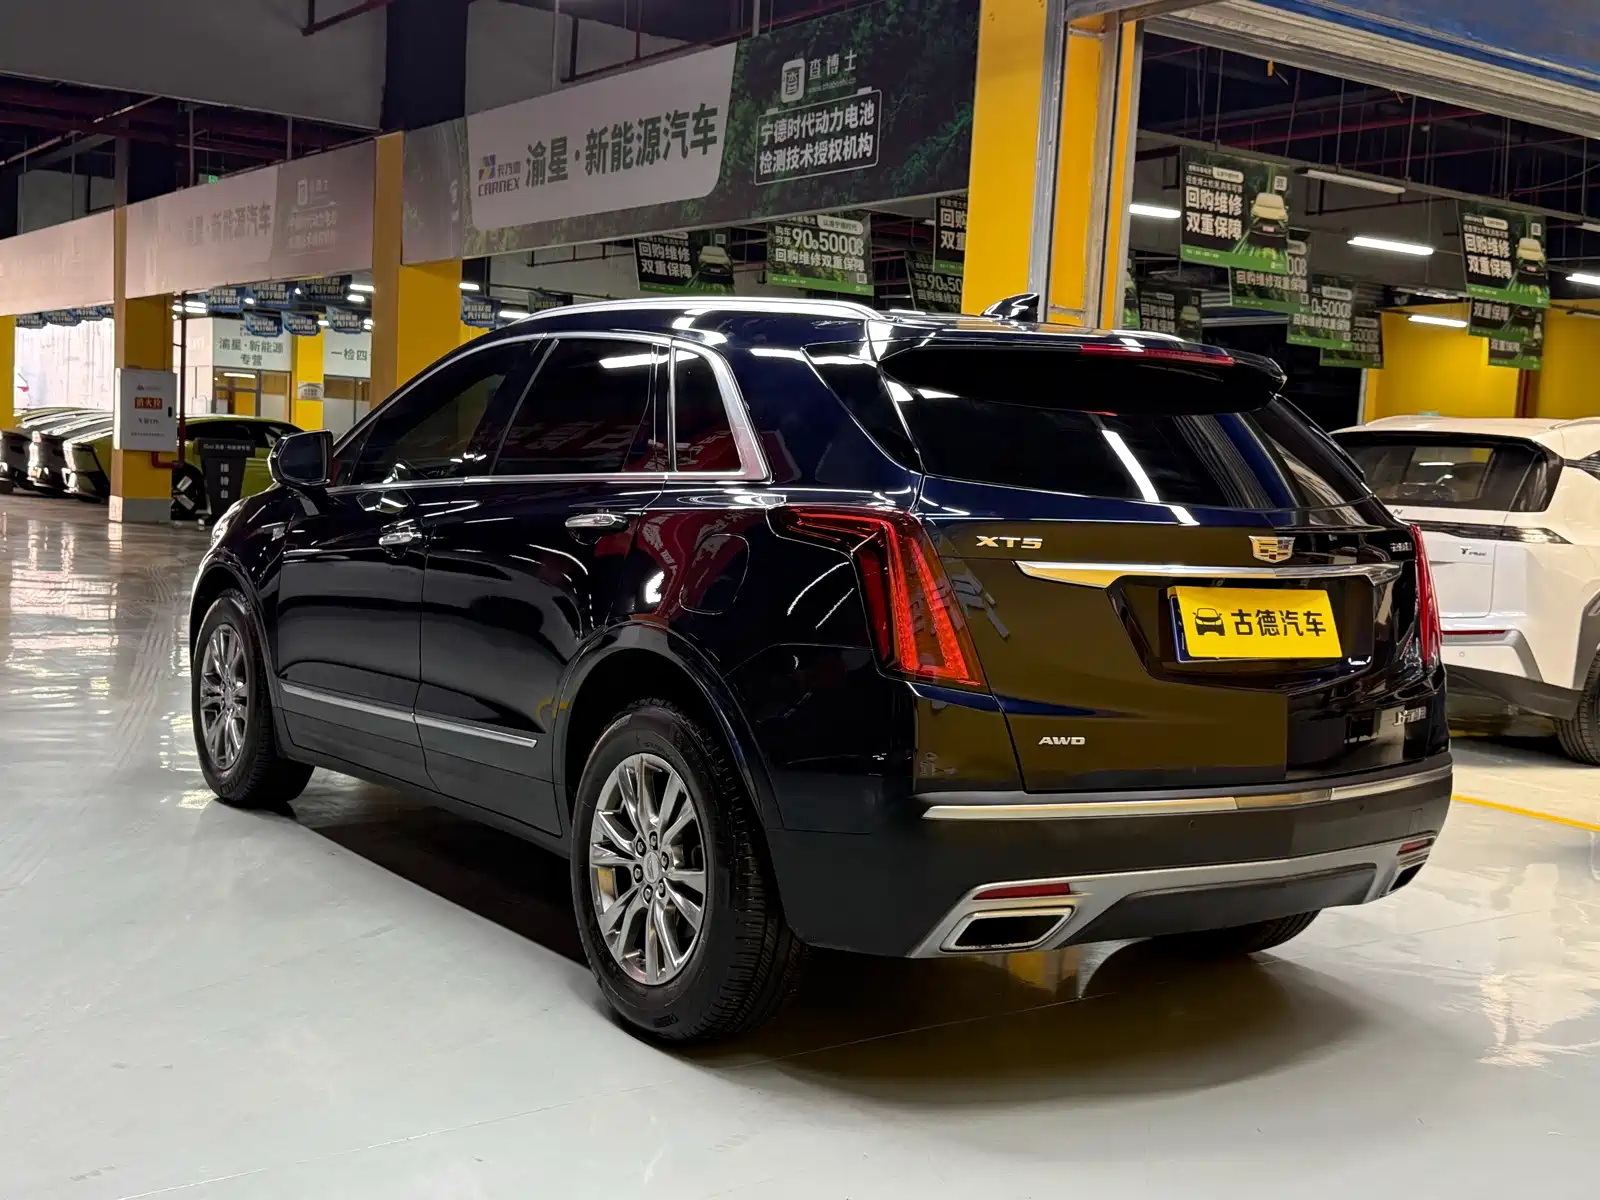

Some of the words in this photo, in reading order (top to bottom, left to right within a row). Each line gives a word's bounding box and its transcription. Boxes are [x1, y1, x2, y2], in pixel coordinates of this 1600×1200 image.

[809, 50, 858, 80] 查博士
[761, 100, 875, 146] 宁德时代动力电池
[760, 132, 874, 176] 检测技术授权机构
[478, 177, 520, 197] CARNEX
[1186, 185, 1242, 216] 回购维修
[1186, 211, 1242, 240] 双重保障
[638, 241, 690, 262] 回购维修
[1464, 233, 1511, 259] 回购维修
[641, 259, 693, 279] 双重保障
[775, 248, 865, 272] 回购维修双重保障
[1467, 255, 1512, 280] 双重保障
[975, 535, 1043, 549] XT5
[1230, 608, 1327, 637] 古德汽车
[1038, 736, 1086, 746] AWD
